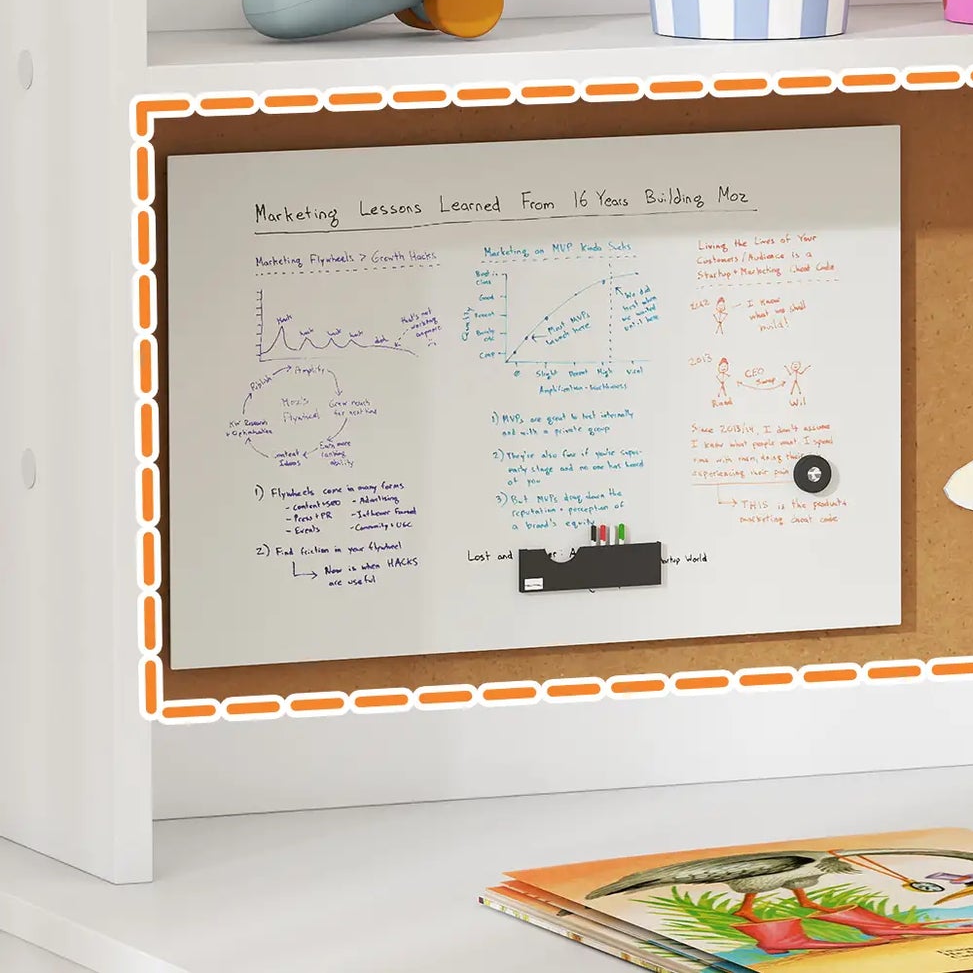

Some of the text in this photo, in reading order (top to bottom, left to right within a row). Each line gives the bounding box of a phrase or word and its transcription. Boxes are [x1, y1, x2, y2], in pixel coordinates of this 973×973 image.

[254, 185, 749, 228] Marketing Lessons Learned From 16 Years Building Moz
[255, 255, 303, 269] Marketing
[310, 251, 355, 266] Flywheels
[371, 249, 406, 264] Growth
[484, 245, 530, 258] Marketing
[468, 548, 707, 563] Lost and World
